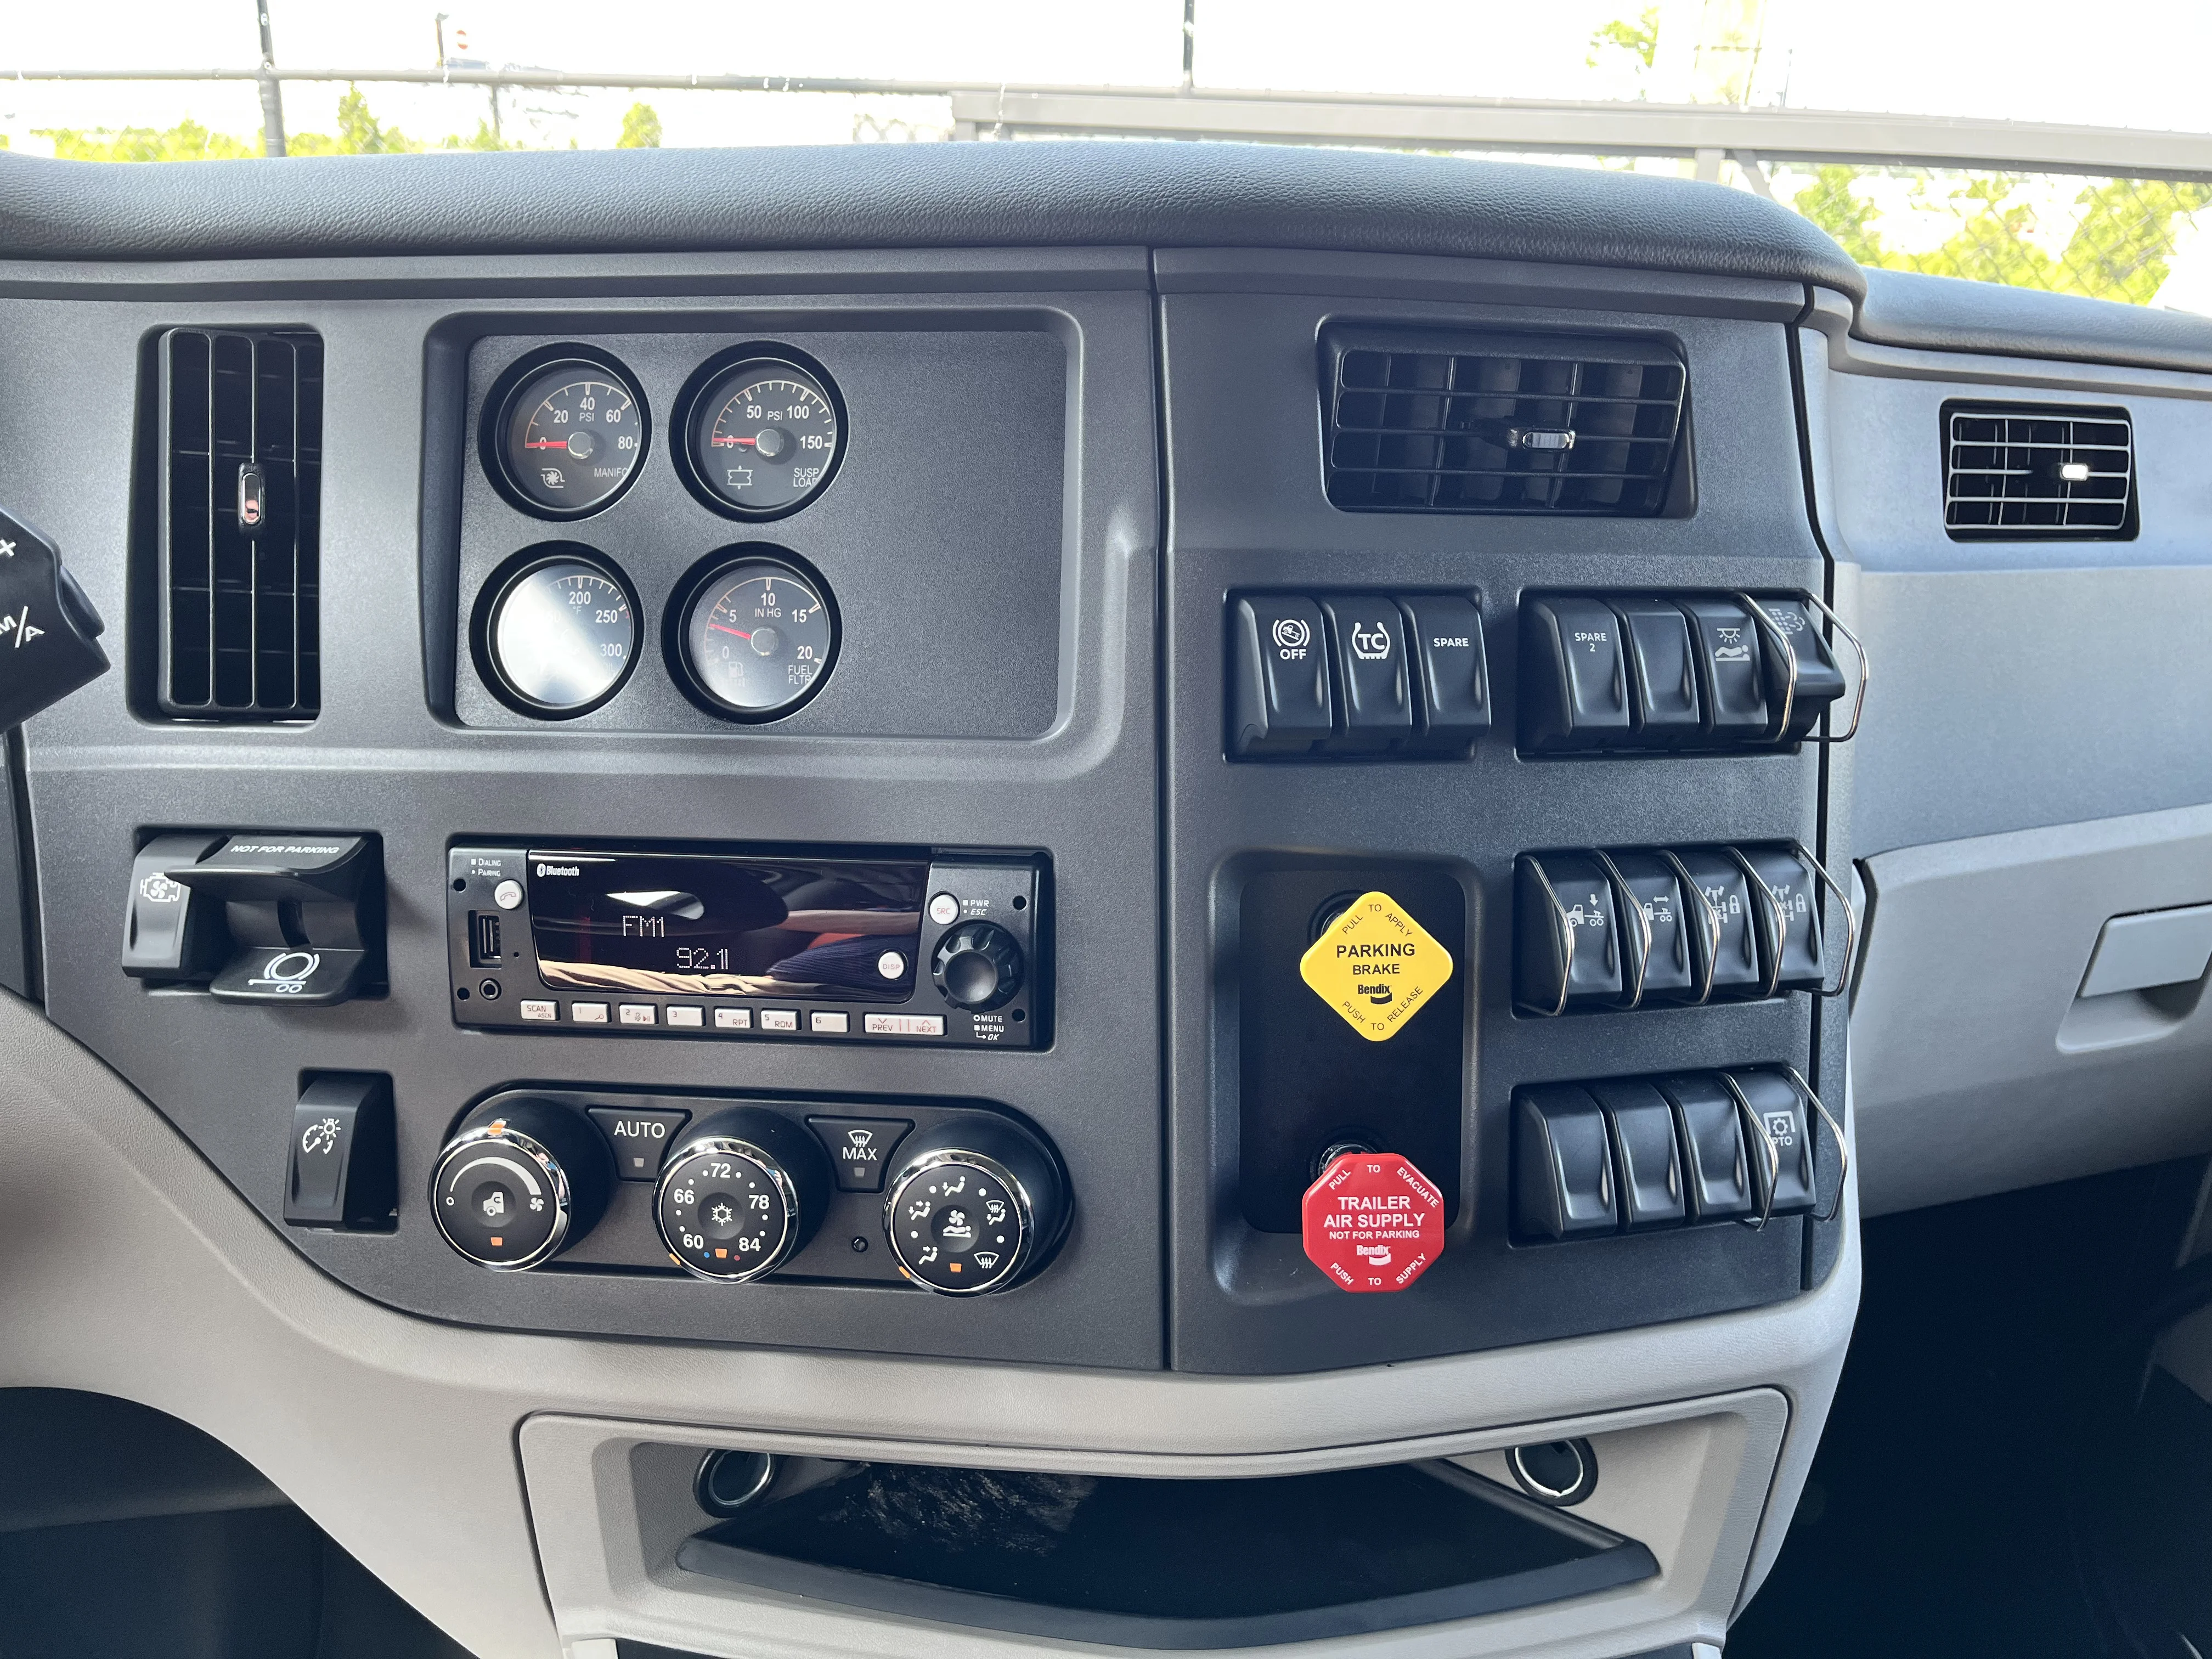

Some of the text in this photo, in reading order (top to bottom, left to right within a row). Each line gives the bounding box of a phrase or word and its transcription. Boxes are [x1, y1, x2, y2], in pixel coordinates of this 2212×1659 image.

[580, 397, 595, 410] 40
[554, 410, 568, 423] 20
[579, 413, 594, 422] PSI
[606, 409, 621, 422] 60
[747, 405, 761, 419] 50
[767, 411, 783, 421] PSI
[787, 405, 809, 419] 100
[618, 436, 633, 449] 80
[800, 436, 822, 449] 150
[793, 467, 819, 477] SUSP
[569, 591, 591, 605] 200
[760, 592, 775, 606] 10
[595, 610, 618, 623] 250
[729, 610, 737, 623] 5
[754, 608, 781, 618] IN HG
[792, 610, 807, 623] 15
[1358, 633, 1386, 650] TC
[1434, 637, 1469, 647] SPARE
[1575, 632, 1607, 642] SPARE
[600, 644, 622, 657] 300
[722, 646, 729, 659] 0
[797, 646, 812, 659] 20
[1589, 643, 1595, 652] 2
[1279, 649, 1307, 660] OFF
[788, 665, 812, 675] FUEL
[545, 865, 579, 876] Bluetooth
[623, 915, 664, 937] FM1
[1342, 915, 1364, 935] PULL
[1385, 913, 1413, 937] APPLY
[1336, 943, 1415, 958] PARKING
[1352, 964, 1400, 975] BRAKE
[1357, 984, 1391, 995] Bendix
[1342, 986, 1424, 1031] PUSH TO RELEASE
[872, 1024, 893, 1032] PREV
[916, 1025, 937, 1034] NEXT
[614, 1120, 666, 1138] AUTO
[1771, 1136, 1792, 1147] PTO
[843, 1147, 877, 1161] MAX
[711, 1163, 731, 1178] 72
[1328, 1164, 1440, 1208] PULL TO EVACUATE
[674, 1188, 695, 1204] 66
[748, 1194, 769, 1210] 78
[1337, 1195, 1411, 1210] TRAILER
[1323, 1213, 1425, 1228] AIR SUPPLY
[683, 1233, 704, 1249] 60
[1329, 1230, 1420, 1239] NOT FOR PARKING
[739, 1237, 761, 1251] 84
[1356, 1245, 1389, 1256] Bendix
[1330, 1252, 1427, 1286] PUSH TO SUPPLY
